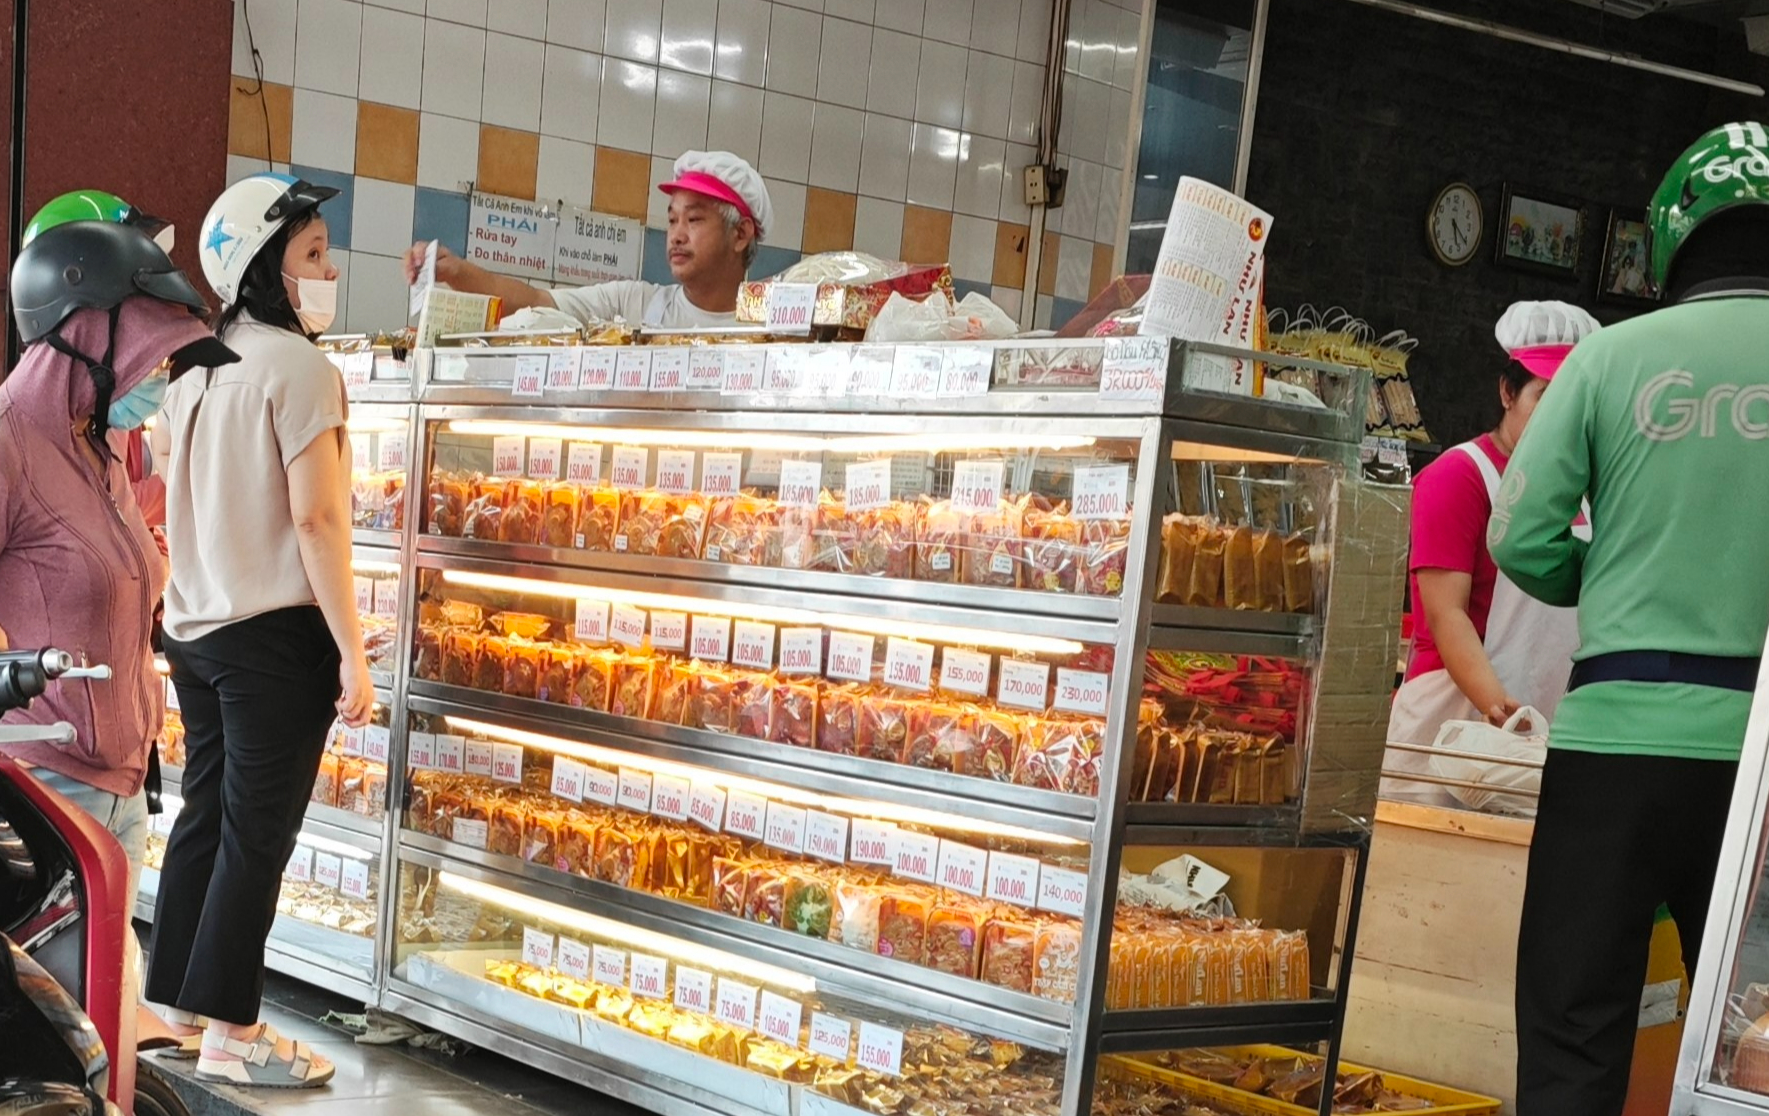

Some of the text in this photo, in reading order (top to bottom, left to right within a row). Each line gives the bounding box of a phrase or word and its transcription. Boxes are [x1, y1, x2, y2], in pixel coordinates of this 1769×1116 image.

[496, 200, 509, 212] Anh
[511, 203, 522, 214] Em
[524, 205, 533, 216] khi
[1453, 195, 1460, 204] 12
[487, 214, 538, 233] PHẢI
[476, 227, 518, 247] Rửa tay
[617, 228, 627, 243] em
[474, 247, 546, 271] Đo thân nhiệt
[1223, 250, 1257, 336] NHƯ LAN
[771, 306, 806, 325] 310.000
[1234, 299, 1252, 386] NHƯ AN
[495, 456, 517, 473] 150.000
[530, 458, 553, 475] 150.000
[569, 463, 593, 480] 150.000
[612, 467, 638, 485] 135.000
[659, 471, 685, 489] 135.000
[704, 475, 731, 492] 135.000
[781, 484, 814, 502] 185.000
[849, 484, 880, 506] 185.000
[1076, 493, 1119, 515] 285.000
[577, 619, 600, 635] 115.000
[654, 626, 682, 639] 115,000
[694, 637, 720, 655] 105.000
[736, 642, 764, 663] 105.000
[782, 649, 811, 668] 105.000
[831, 653, 861, 675] 105.000
[889, 661, 921, 683] 155.000
[946, 665, 983, 684] 155,000
[1004, 678, 1042, 696] 170,000
[1061, 685, 1102, 703] 230,000
[494, 761, 515, 779] 125.000
[556, 776, 577, 797] 85.000
[656, 794, 681, 815] 85.000
[690, 797, 714, 823] 85.000
[730, 811, 756, 832] 85.000
[768, 825, 796, 846] 135.000
[808, 833, 838, 855] 150.000
[855, 840, 886, 861] 190.000
[897, 852, 927, 875] 100.000
[944, 864, 973, 889] 100.000
[994, 875, 1026, 899] 100.000
[1043, 883, 1083, 904] 140,000
[634, 973, 658, 993] 75.000
[678, 986, 702, 1007] 75.000
[721, 999, 746, 1022] 75.000
[764, 1014, 790, 1038] 105.000
[861, 1044, 891, 1068] 155.000
